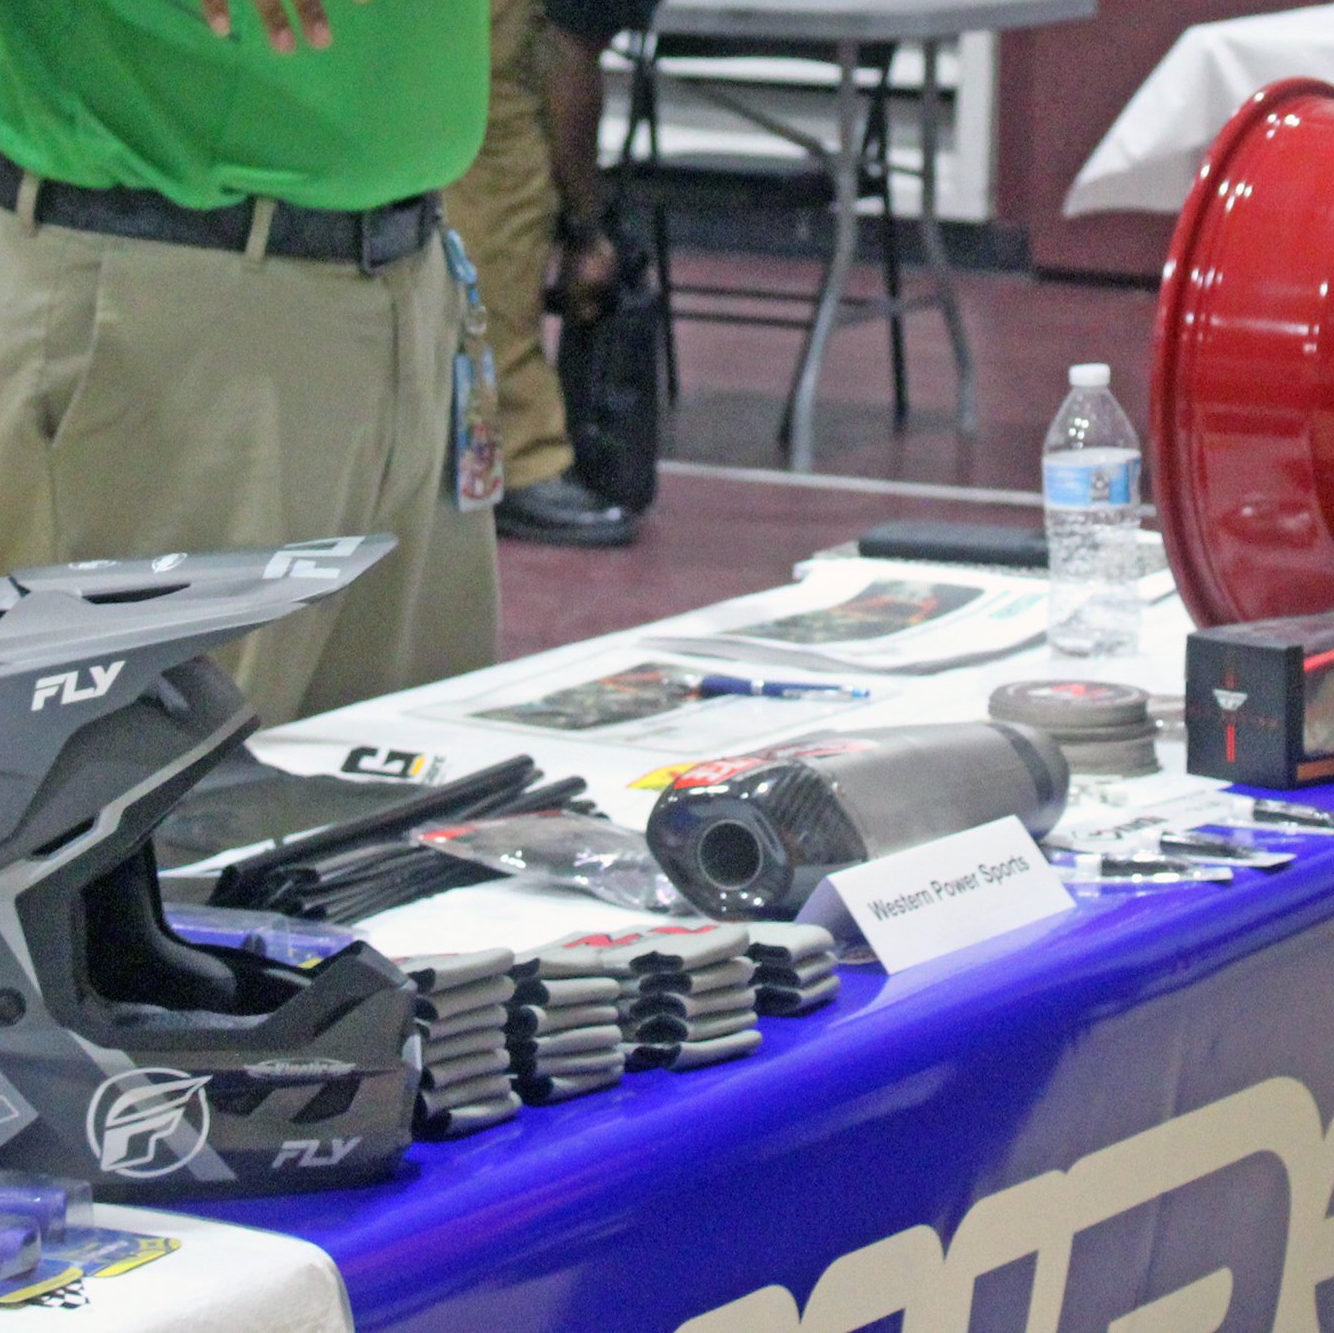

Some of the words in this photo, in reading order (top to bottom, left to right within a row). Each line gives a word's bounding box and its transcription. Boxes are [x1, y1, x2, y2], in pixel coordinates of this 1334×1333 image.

[30, 659, 126, 712] FLY
[867, 888, 935, 921] Western
[929, 872, 981, 902] Power
[977, 853, 1030, 886] Sports
[271, 1135, 364, 1170] FLY
